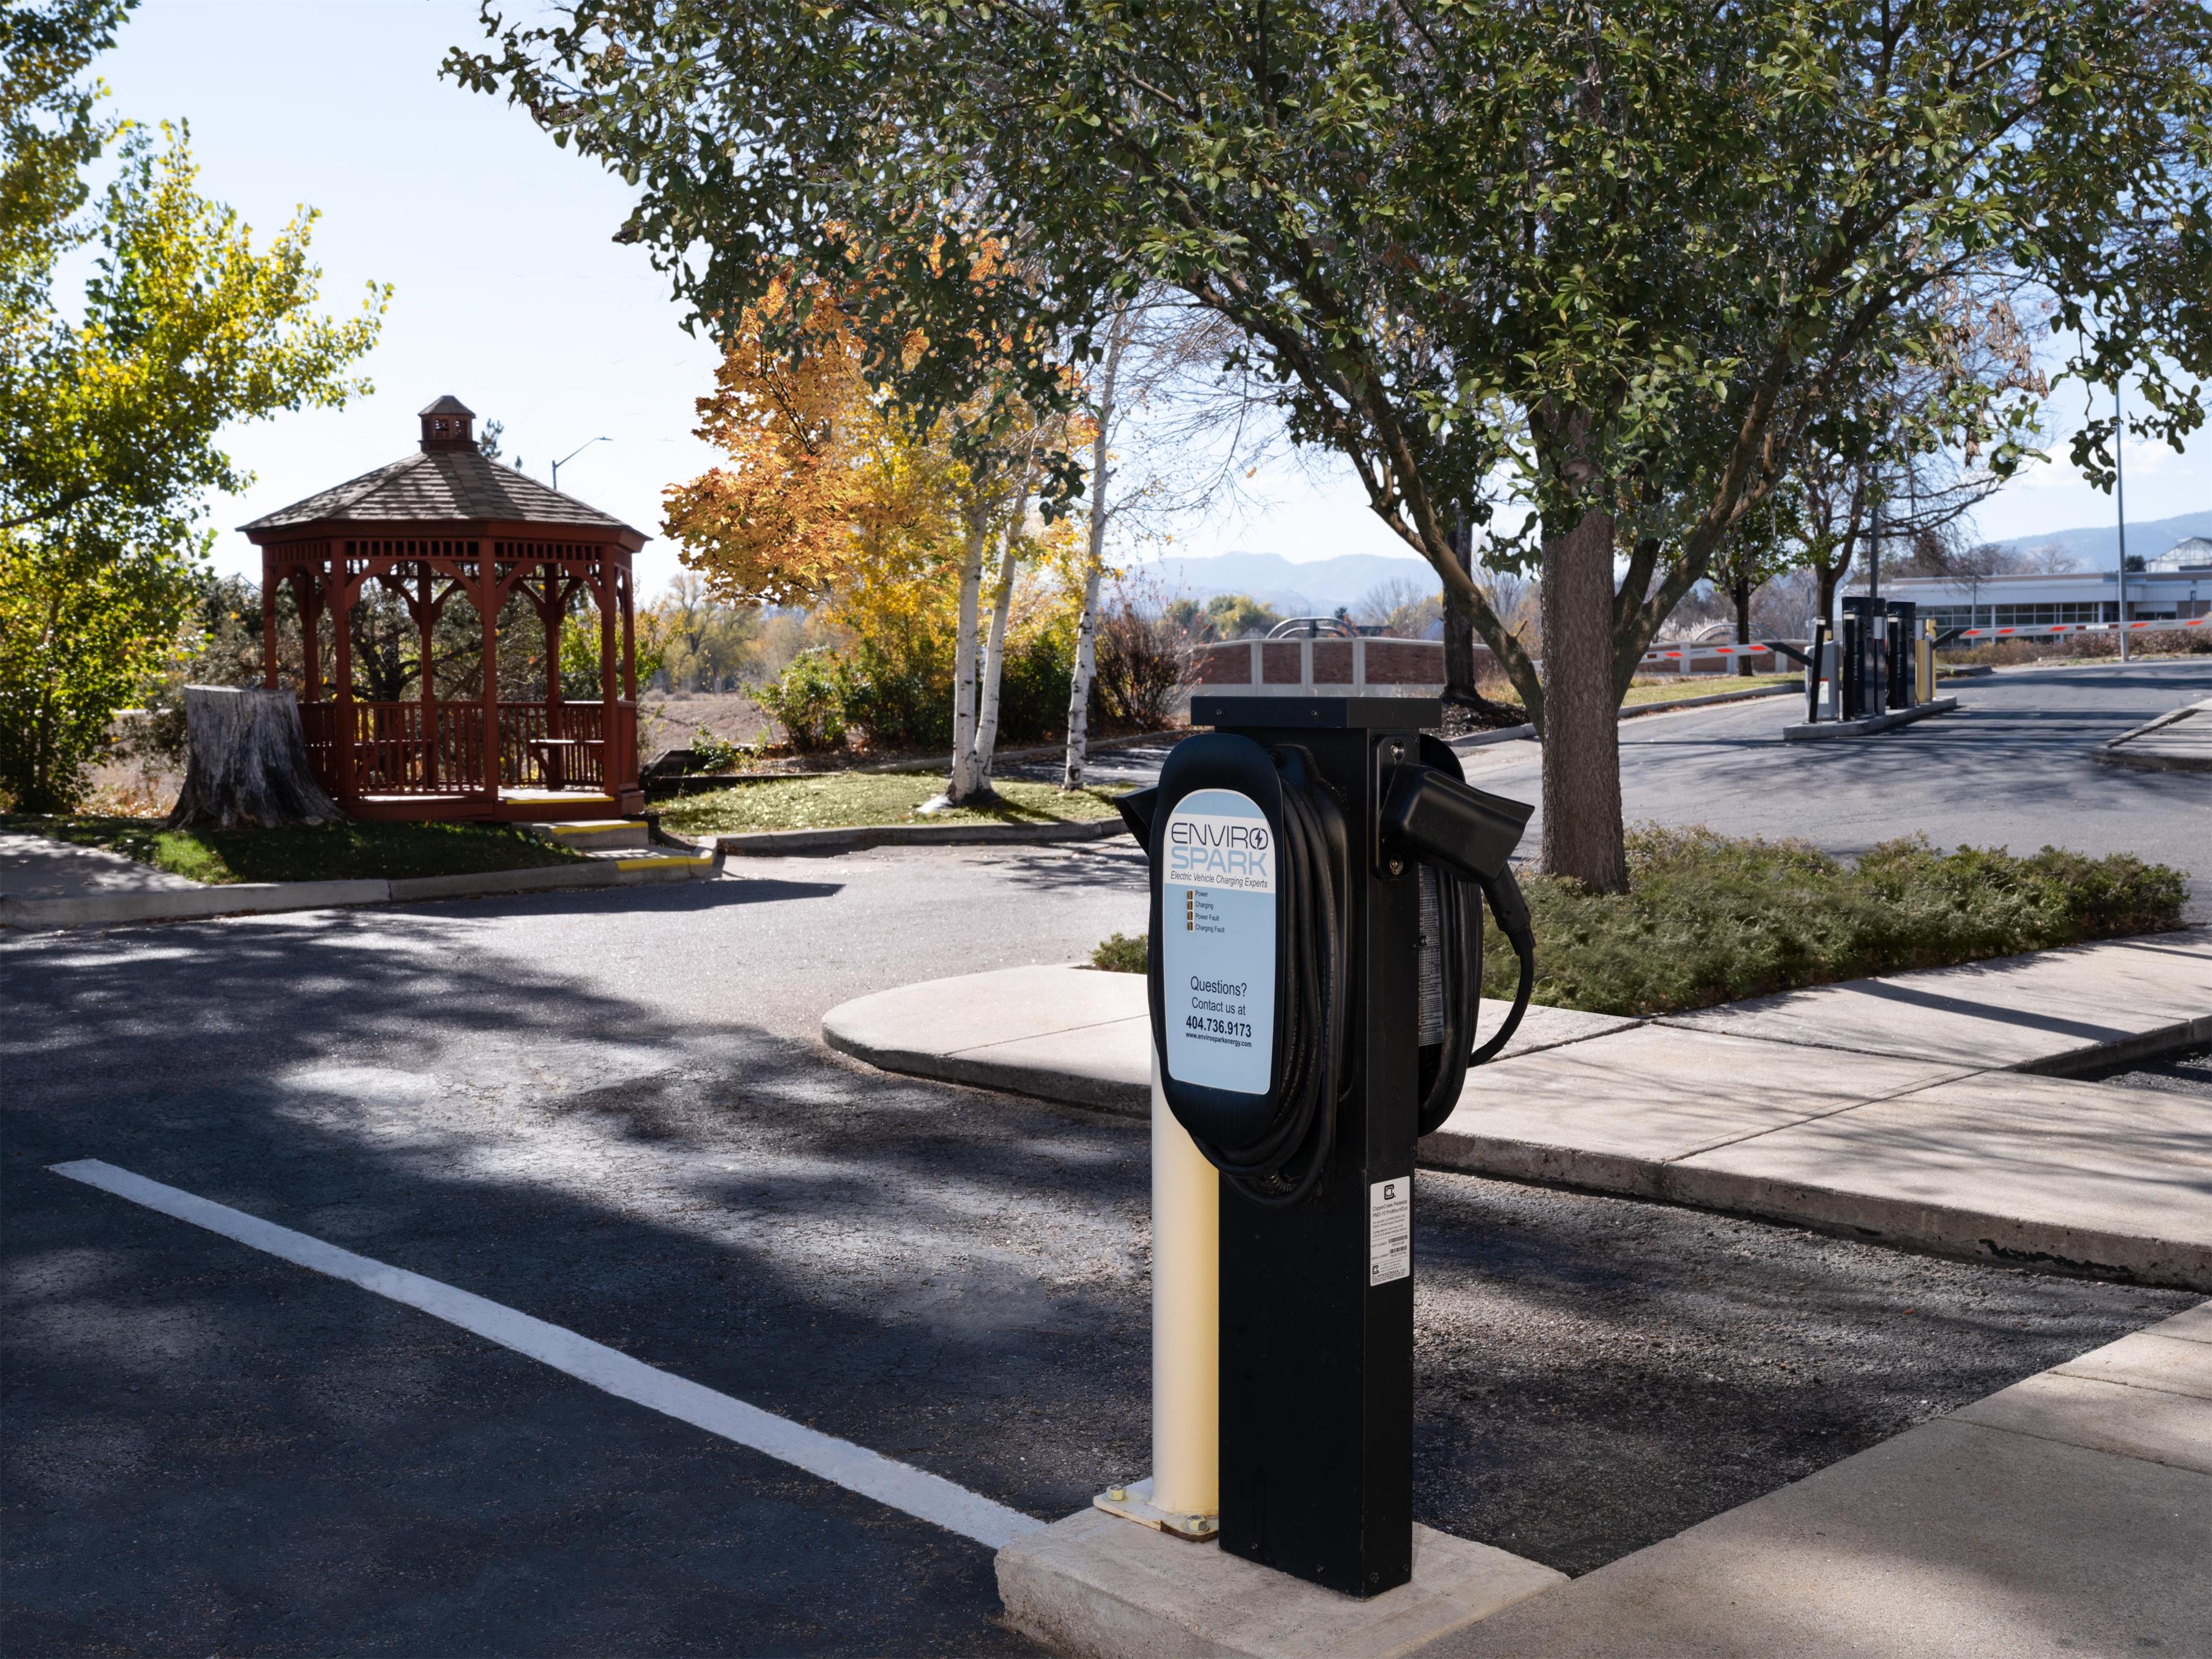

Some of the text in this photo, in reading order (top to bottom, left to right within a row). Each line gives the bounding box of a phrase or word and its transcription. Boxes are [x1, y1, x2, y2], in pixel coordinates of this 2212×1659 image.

[1171, 822, 1268, 850] ENVIRO
[1171, 846, 1267, 877] SPARK
[1171, 870, 1268, 889] Electric Vehicle Charging Experts
[1195, 901, 1214, 910] Charging
[1195, 924, 1214, 933] Charging
[1191, 976, 1247, 997] Questions?
[1192, 997, 1246, 1016] Contact us at
[1186, 1015, 1252, 1037] 404.736.9173
[1185, 1032, 1252, 1048] www.envirosparkenergy.com
